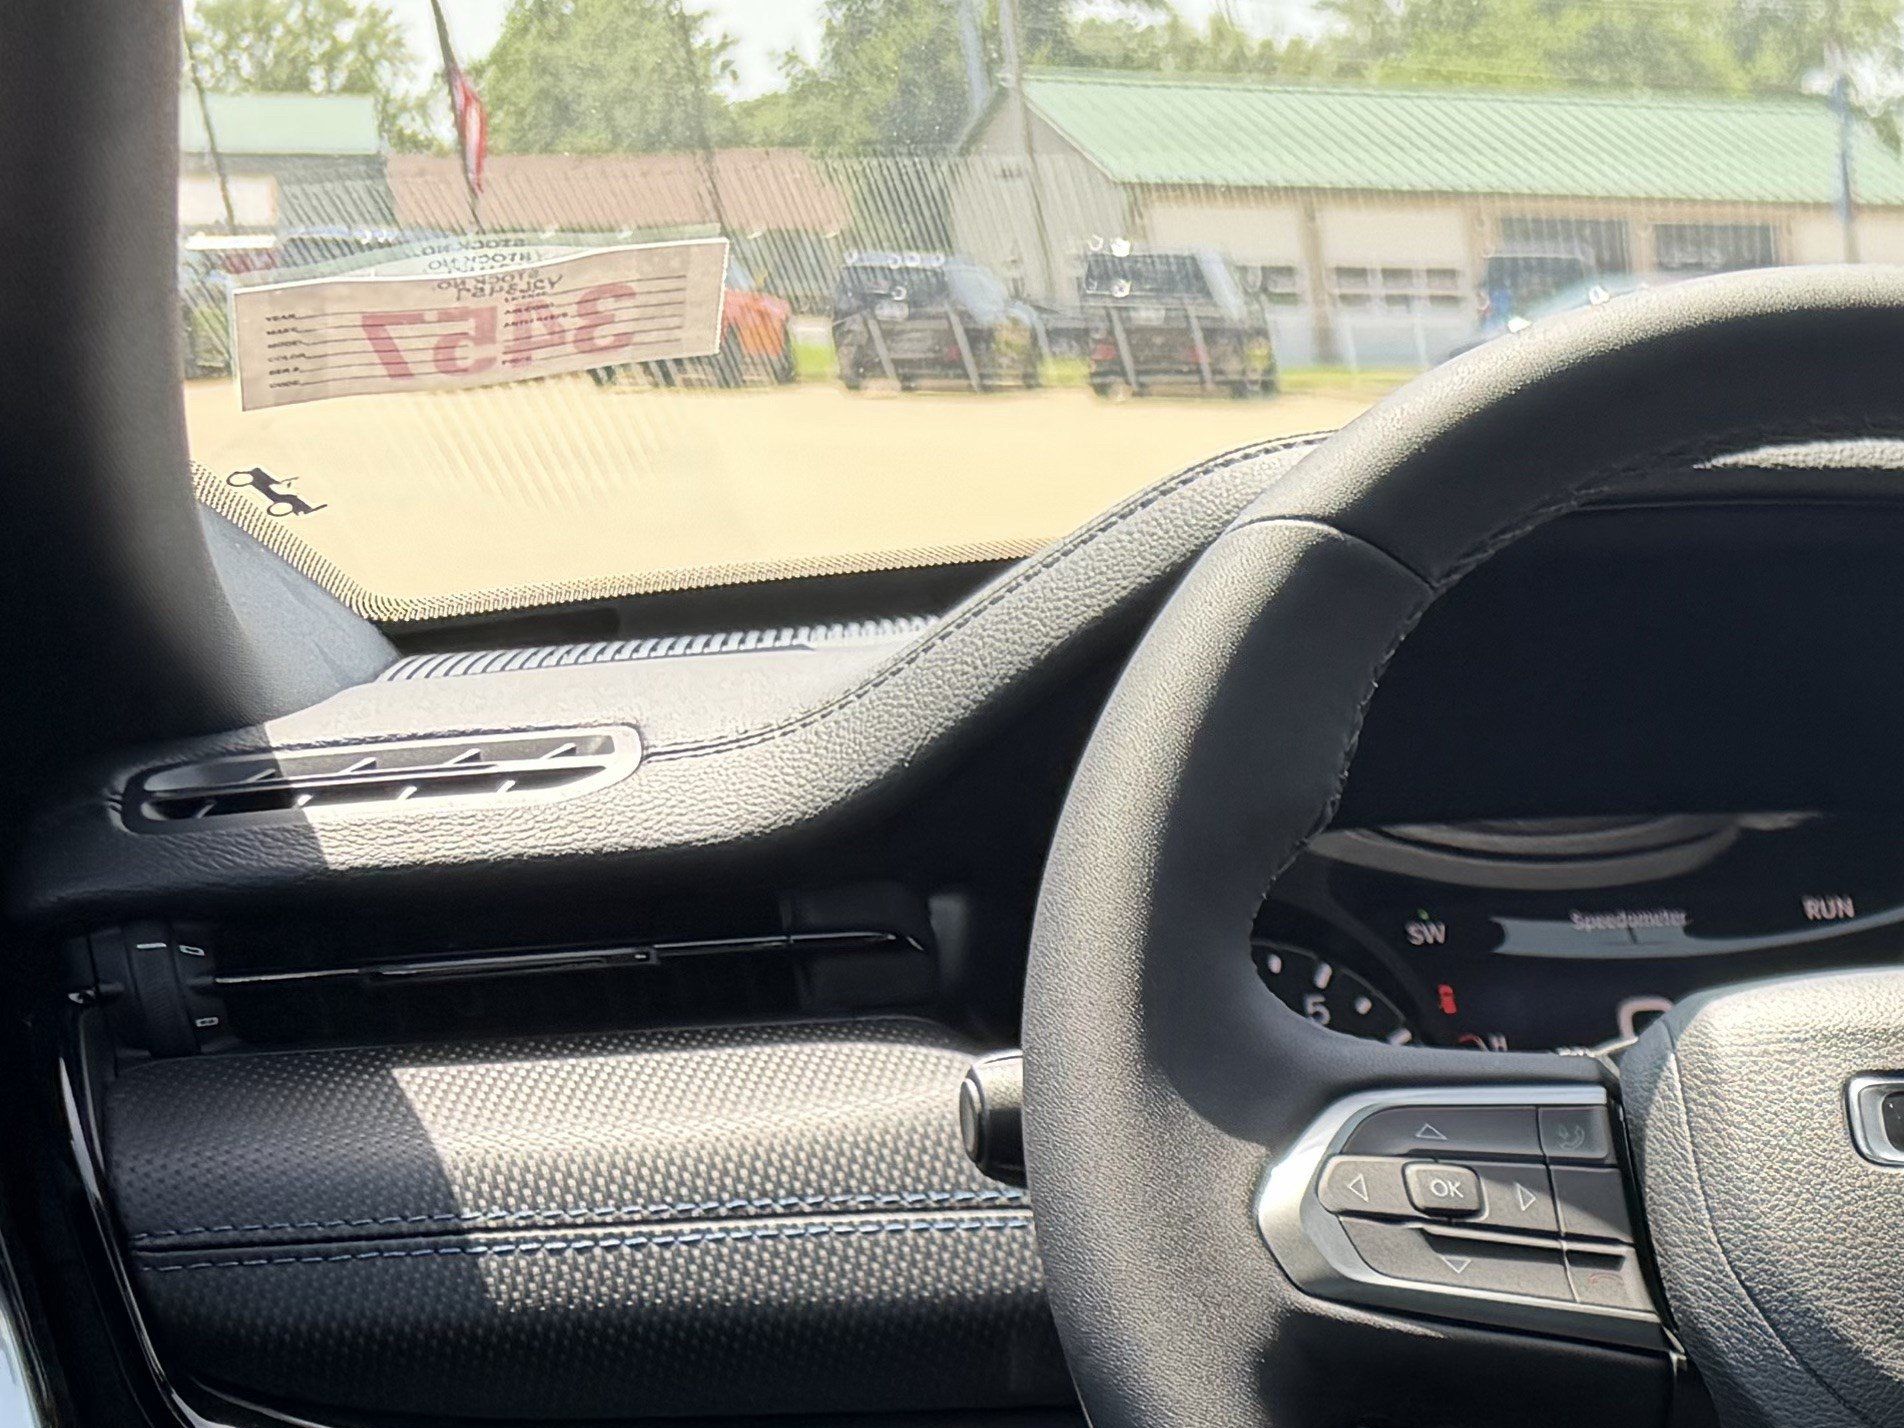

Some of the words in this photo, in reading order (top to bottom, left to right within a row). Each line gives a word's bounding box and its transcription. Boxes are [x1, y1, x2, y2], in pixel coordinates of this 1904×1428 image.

[1802, 893, 1856, 921] RUN
[1405, 920, 1446, 946] SW
[1569, 909, 1687, 933] Speedometer
[1304, 993, 1332, 1026] 5
[1430, 1179, 1464, 1198] OK
